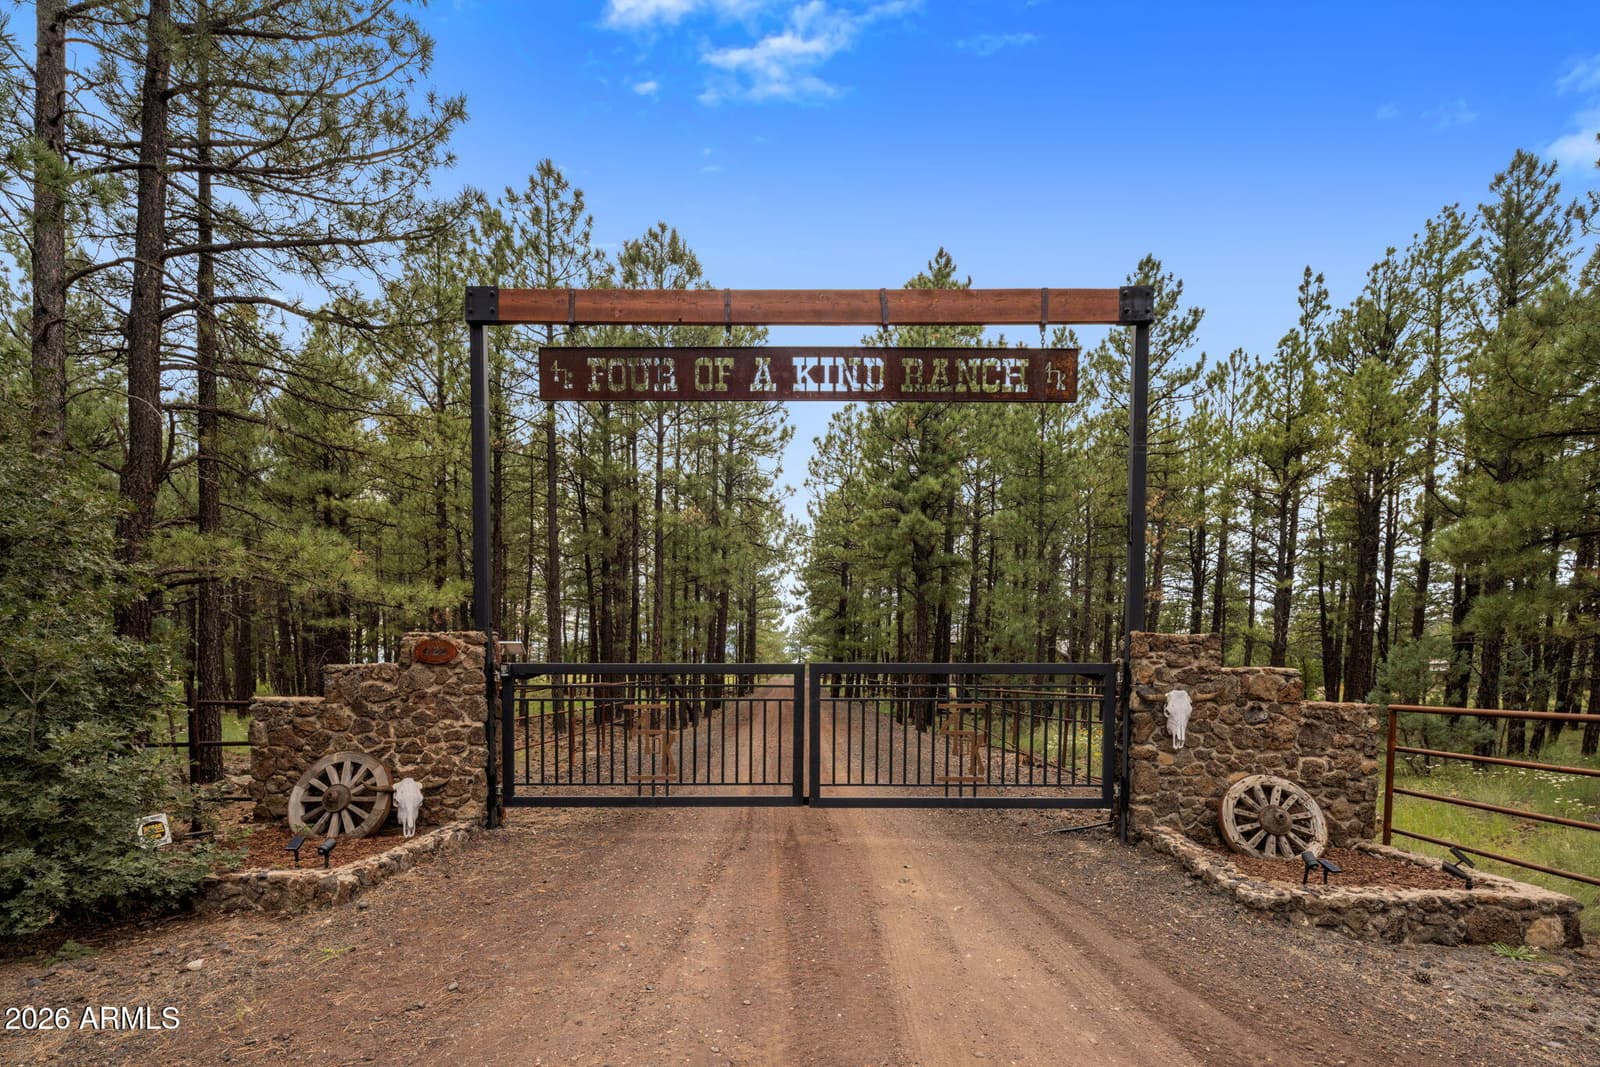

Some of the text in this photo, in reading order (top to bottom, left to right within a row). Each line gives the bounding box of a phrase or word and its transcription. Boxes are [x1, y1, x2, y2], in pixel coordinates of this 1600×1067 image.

[587, 357, 678, 392] FOUR
[695, 357, 734, 392] OF
[750, 357, 776, 392] A
[792, 357, 885, 392] KIND
[901, 358, 1030, 392] RANCH
